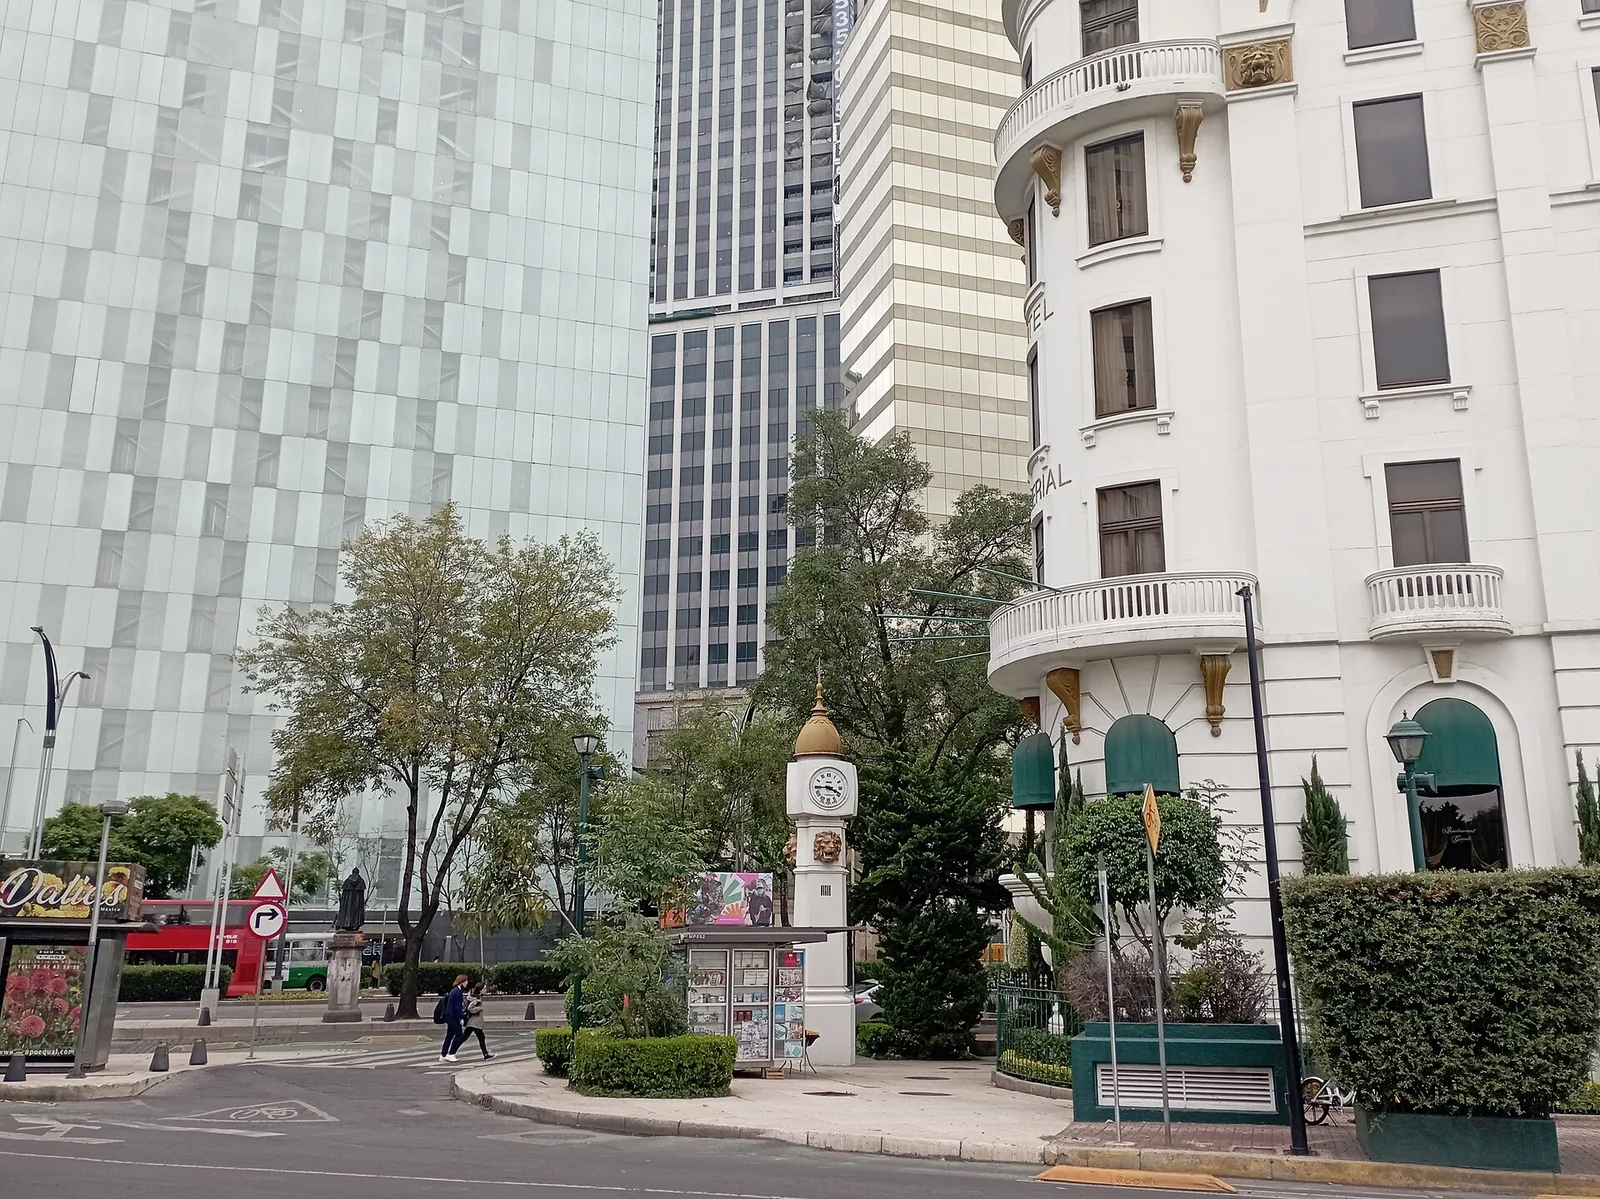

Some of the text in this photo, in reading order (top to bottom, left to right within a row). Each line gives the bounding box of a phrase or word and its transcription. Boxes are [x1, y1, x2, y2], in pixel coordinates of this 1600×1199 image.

[1026, 299, 1054, 344] TEL
[1030, 463, 1072, 510] ERIAL
[0, 867, 124, 909] Dalias
